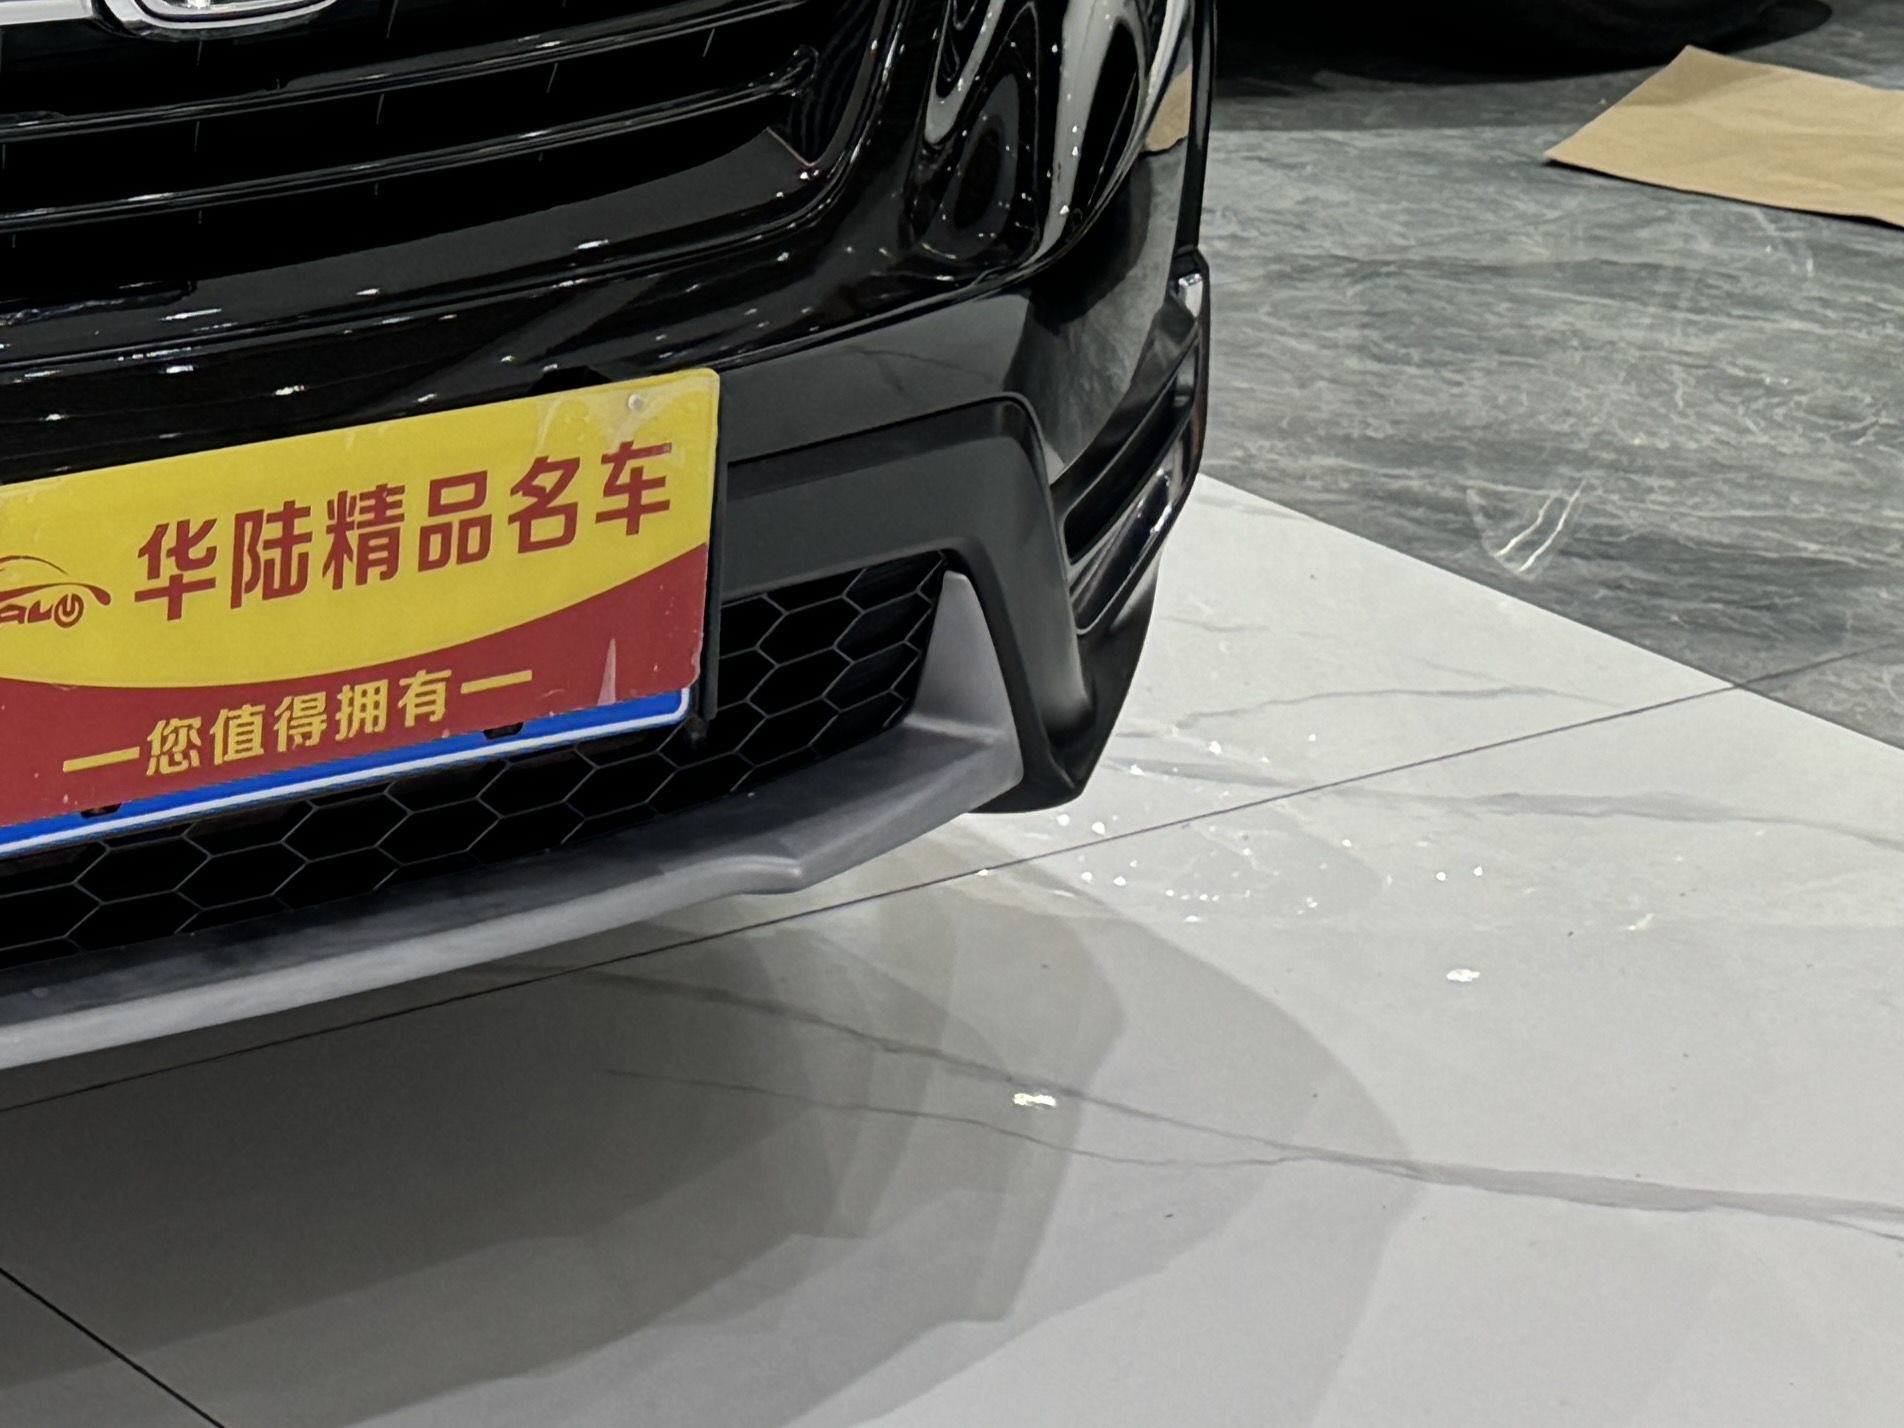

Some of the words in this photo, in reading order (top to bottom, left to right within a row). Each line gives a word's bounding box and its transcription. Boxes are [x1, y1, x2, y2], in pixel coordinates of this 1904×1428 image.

[133, 440, 673, 621] 华陆精品名车
[146, 668, 453, 778] 您值得拥有
